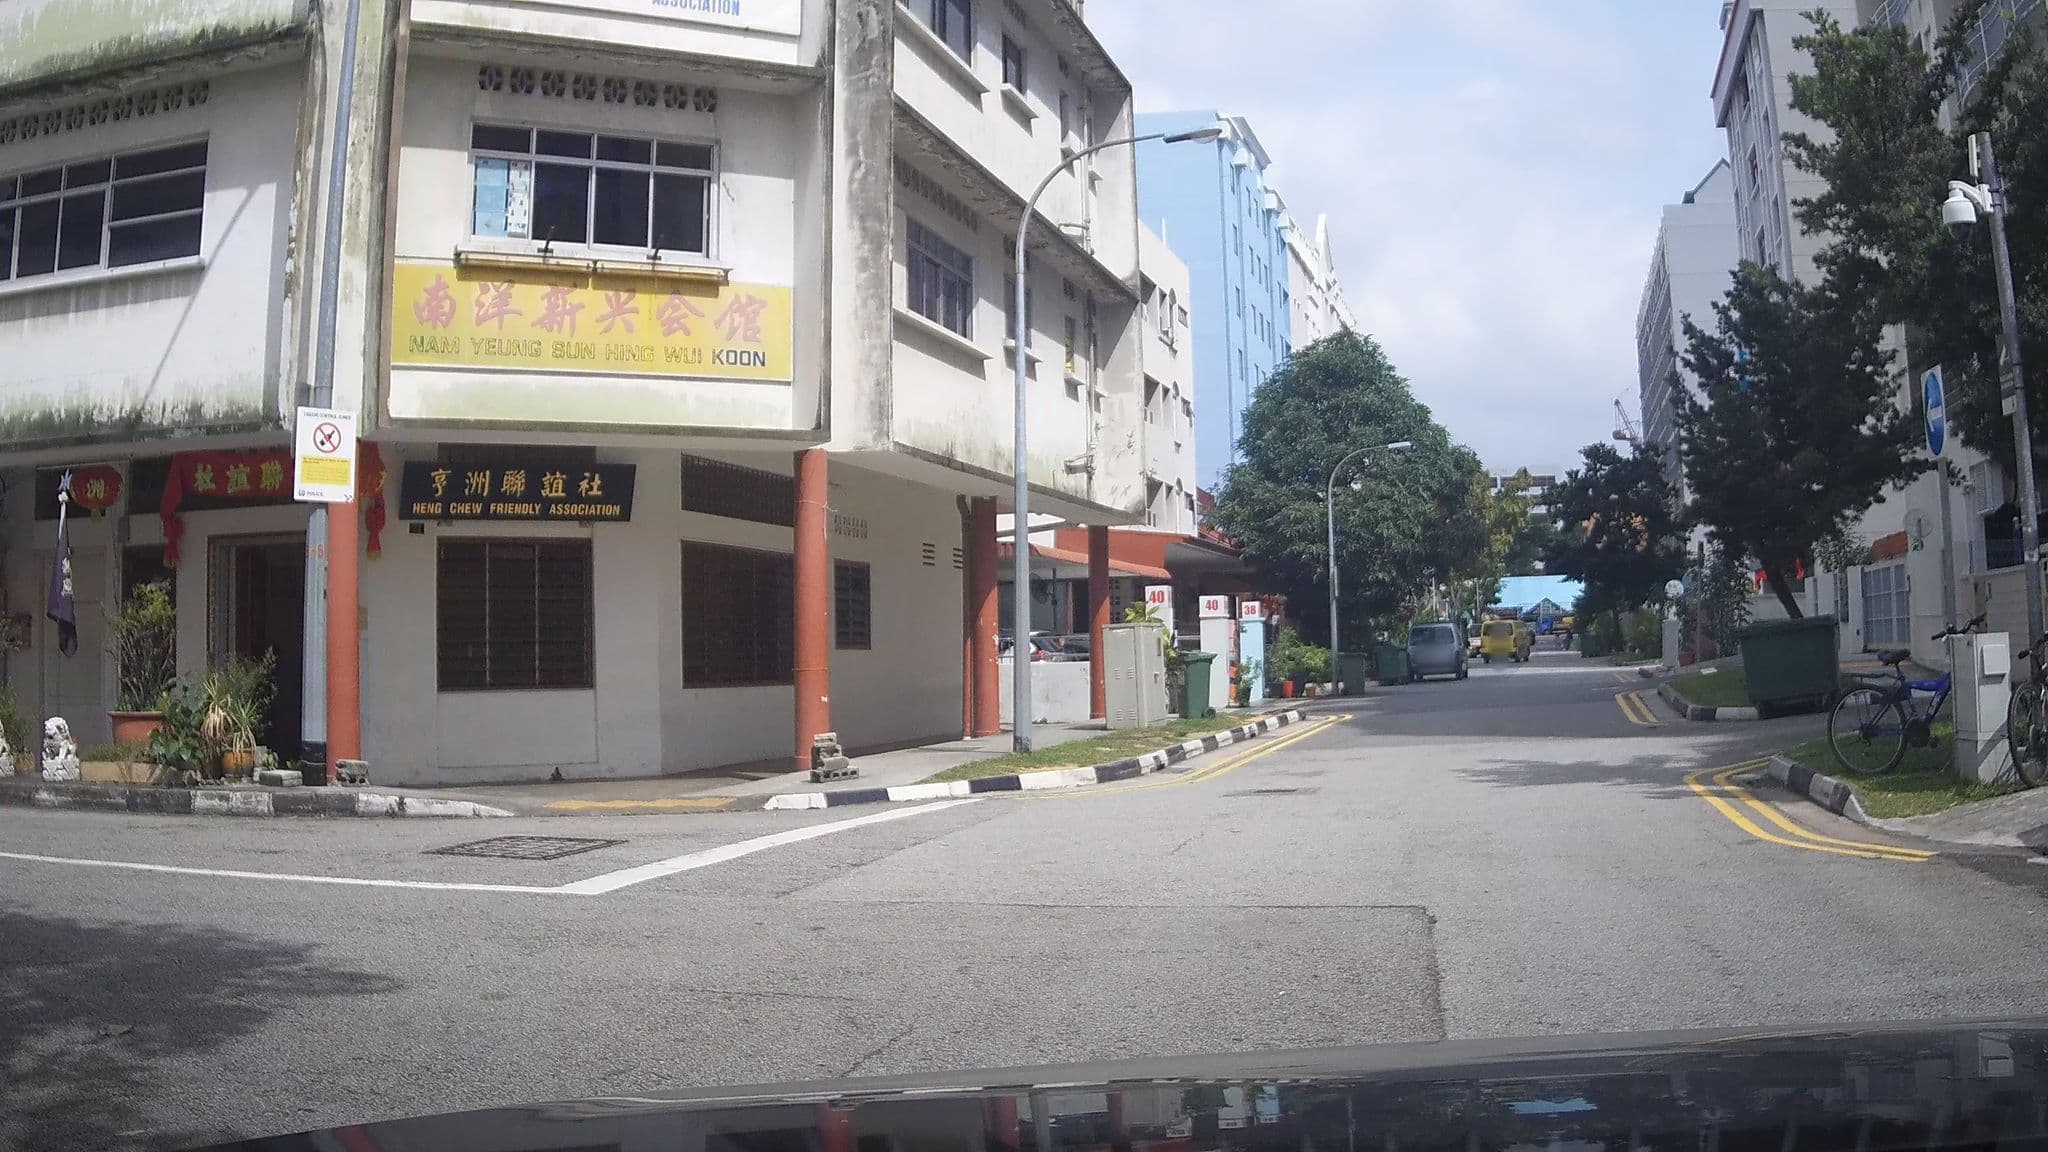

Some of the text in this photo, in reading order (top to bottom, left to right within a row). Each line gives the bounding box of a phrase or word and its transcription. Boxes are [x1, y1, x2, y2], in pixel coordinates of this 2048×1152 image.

[413, 274, 768, 342] 南洋新兴会馆
[409, 335, 766, 367] NAM YEUNG SUN HING WUI KOON
[413, 502, 620, 515] HENG CHEW FRIENDLY ASSOCIATION
[1149, 590, 1164, 603] 40
[1205, 599, 1218, 610] 40
[1244, 605, 1256, 615] 38
